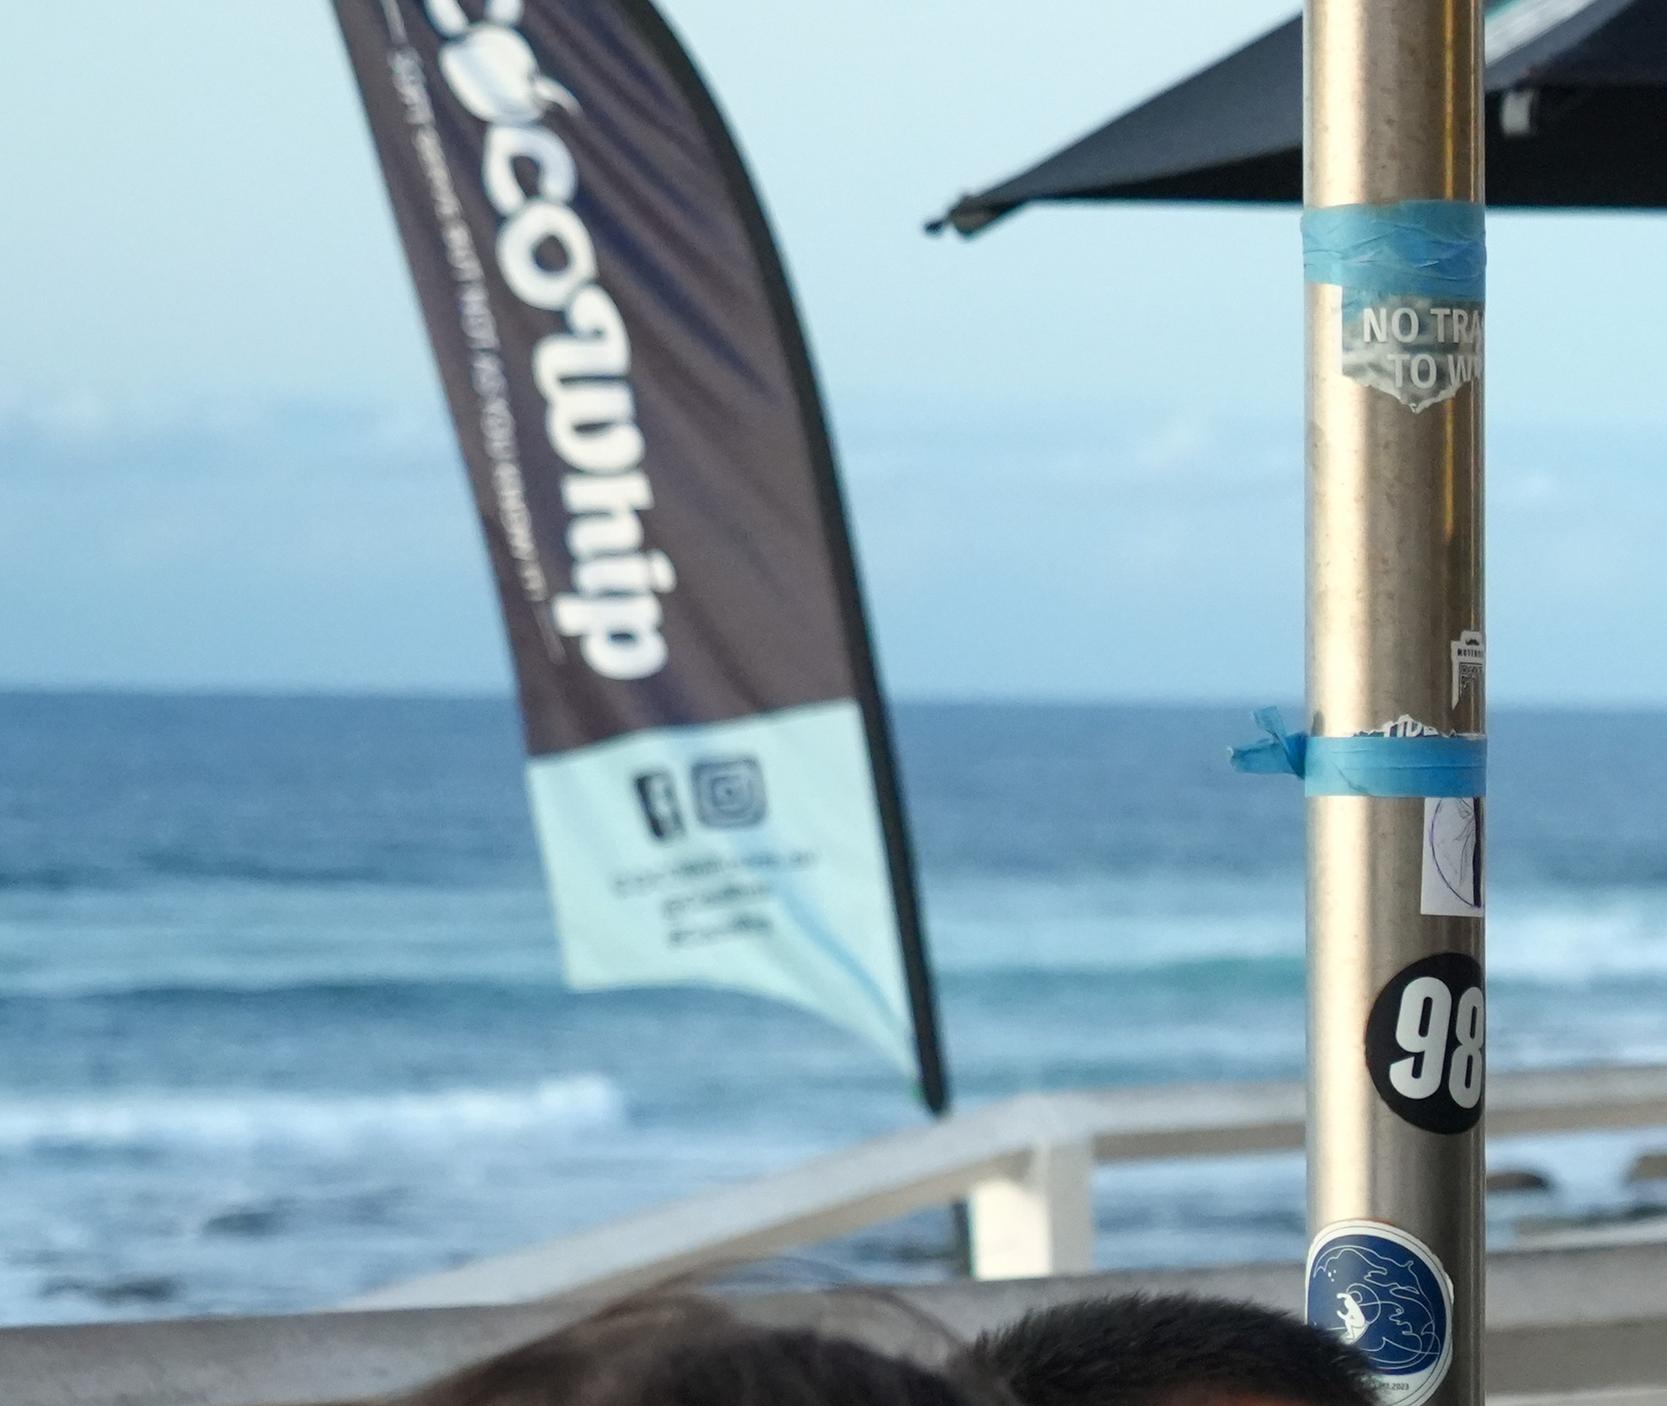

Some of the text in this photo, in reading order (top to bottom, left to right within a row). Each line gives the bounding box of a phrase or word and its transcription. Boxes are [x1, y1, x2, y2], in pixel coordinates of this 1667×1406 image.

[1362, 307, 1483, 344] NO TRA
[1388, 353, 1437, 390] TO
[1388, 976, 1484, 1110] 98
